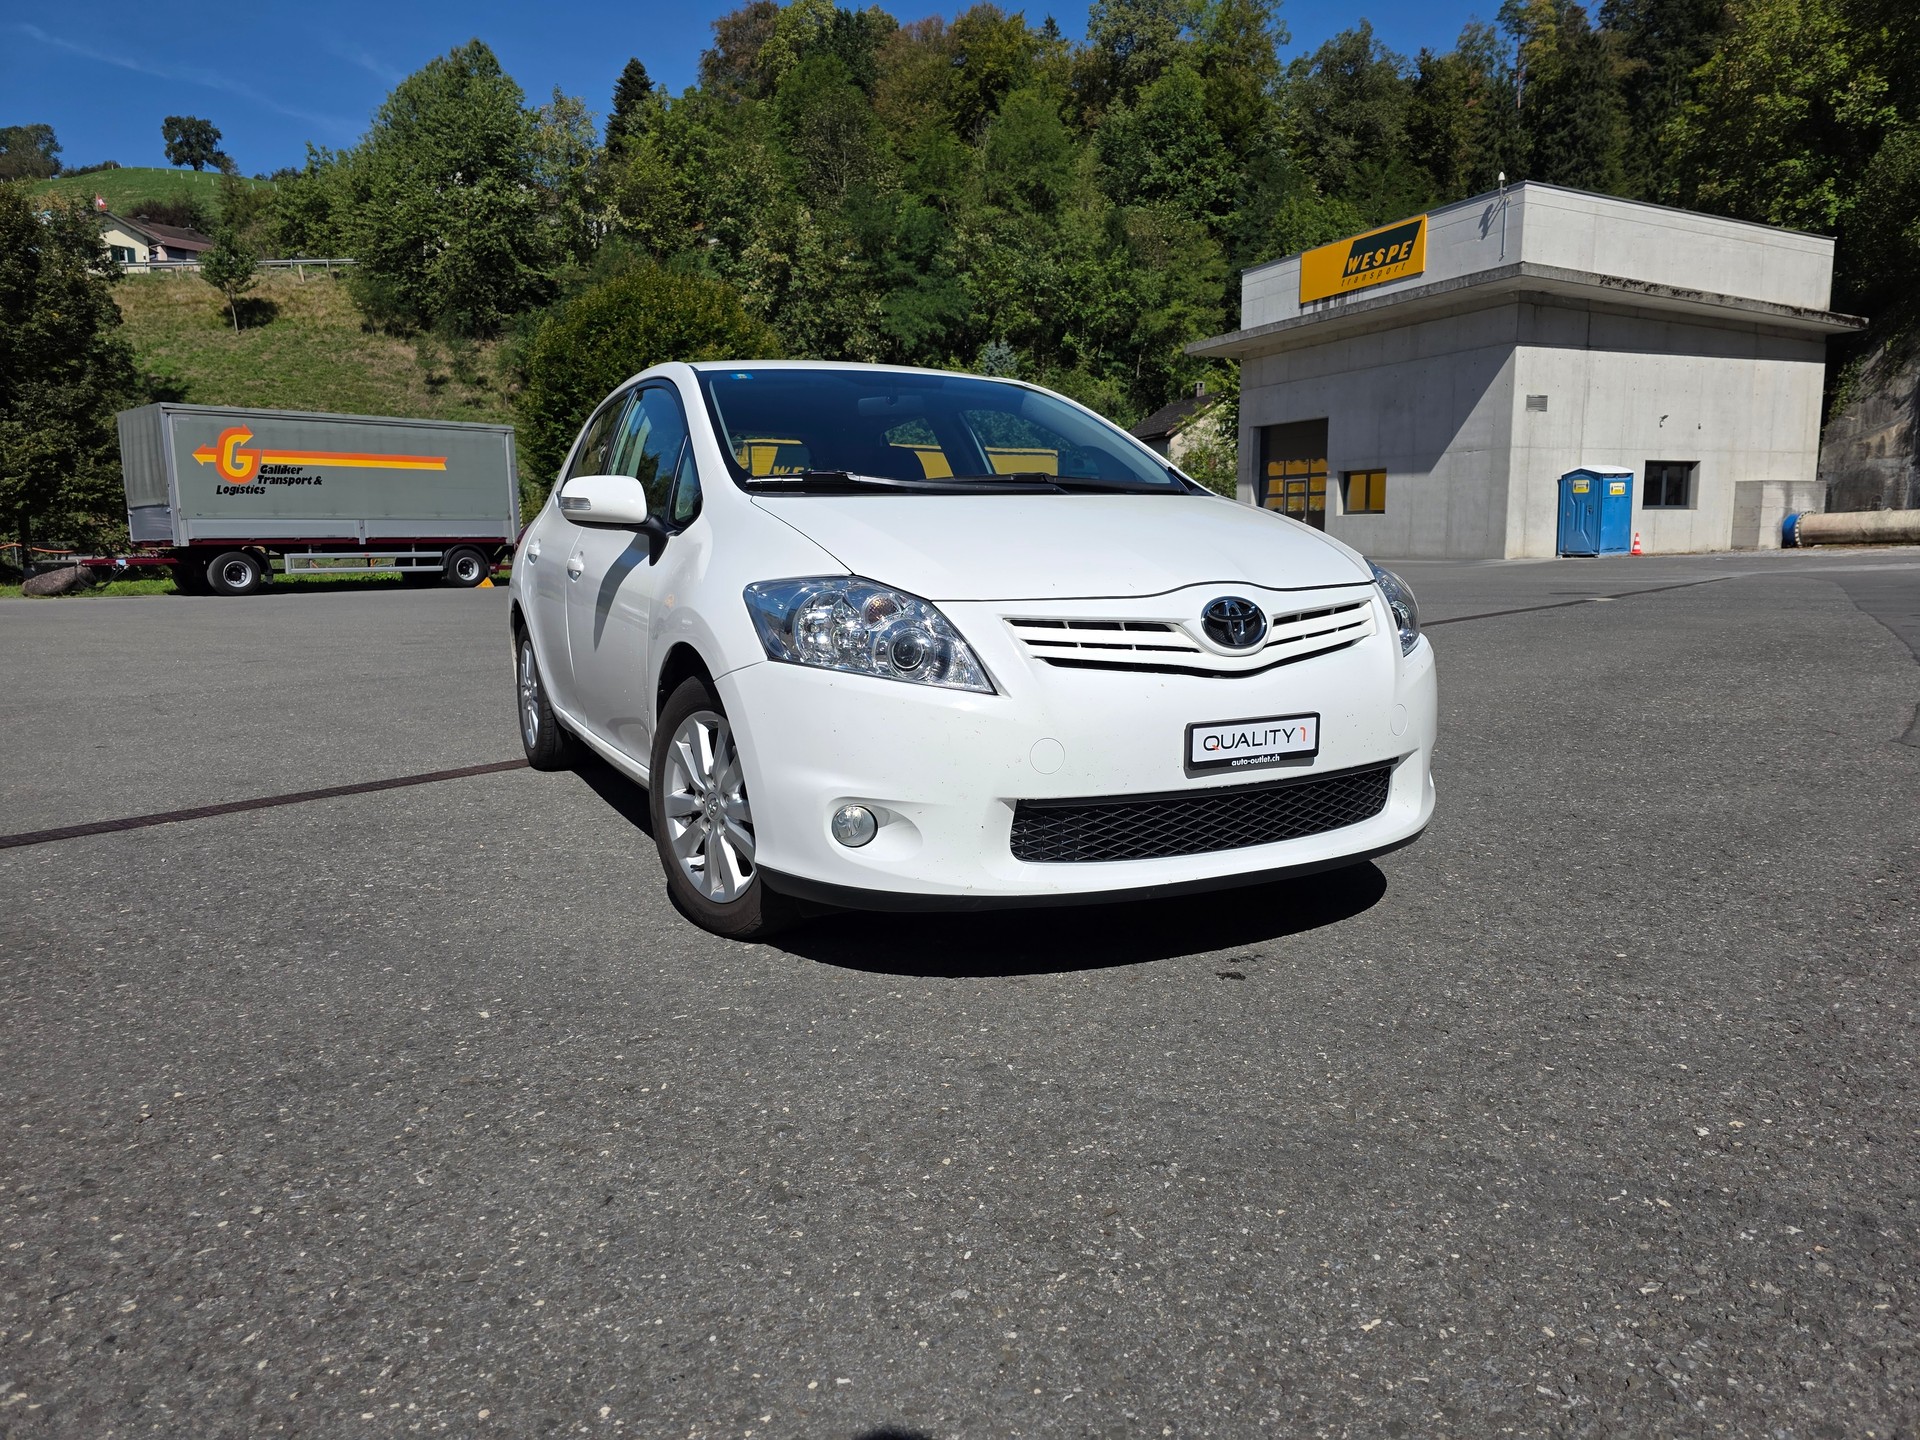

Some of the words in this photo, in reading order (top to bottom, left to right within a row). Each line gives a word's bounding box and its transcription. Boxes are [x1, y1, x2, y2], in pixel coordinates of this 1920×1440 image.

[1347, 240, 1413, 274] WESPE
[1341, 262, 1406, 287] transport
[260, 465, 303, 475] Galliker
[257, 475, 313, 486] Transport
[313, 476, 323, 485] &
[216, 484, 265, 496] Logistics
[1231, 754, 1280, 767] auto-outlet.ch
